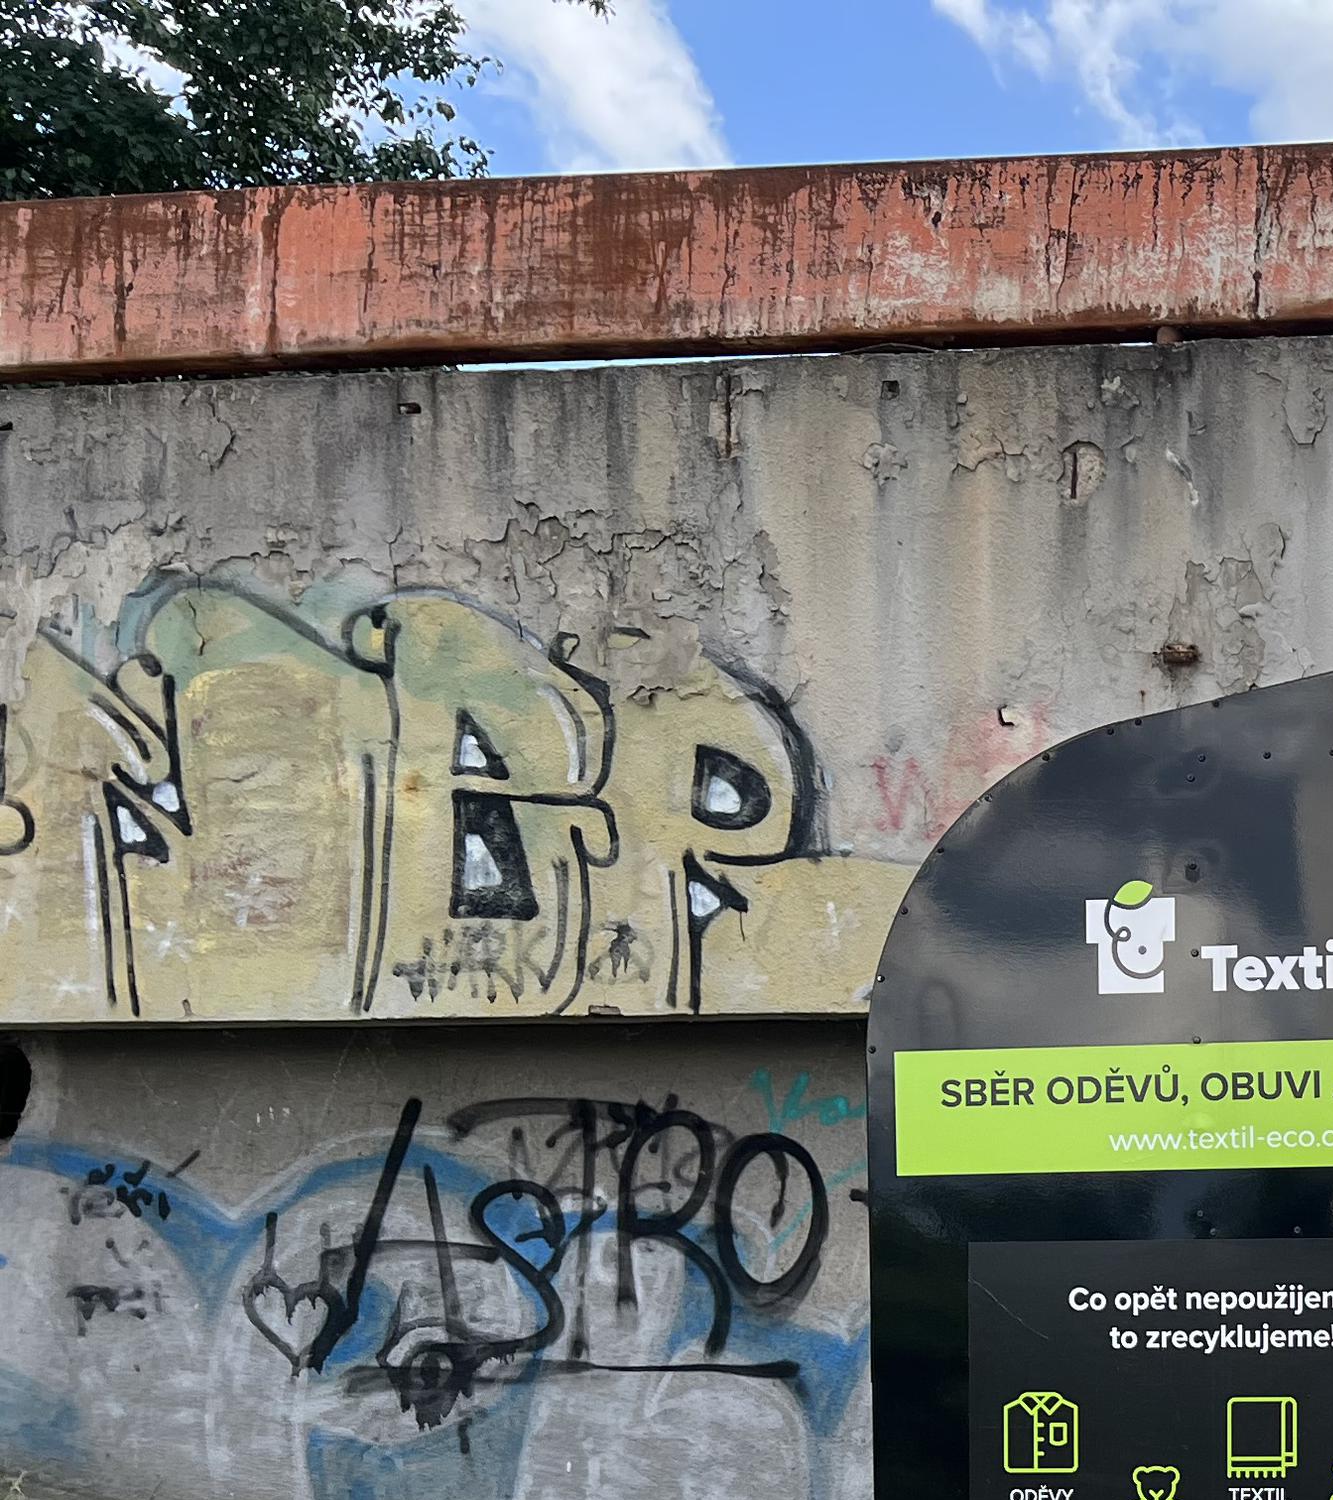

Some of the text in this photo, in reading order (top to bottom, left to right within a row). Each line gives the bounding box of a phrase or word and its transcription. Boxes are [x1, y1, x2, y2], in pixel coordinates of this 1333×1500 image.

[941, 1069, 1034, 1108] SBĚR
[1047, 1064, 1190, 1107] ODĚVŮ,
[1201, 1069, 1322, 1102] OBUVI
[1068, 1287, 1107, 1312] Co
[1114, 1285, 1177, 1315] opět
[1109, 1325, 1138, 1350] to
